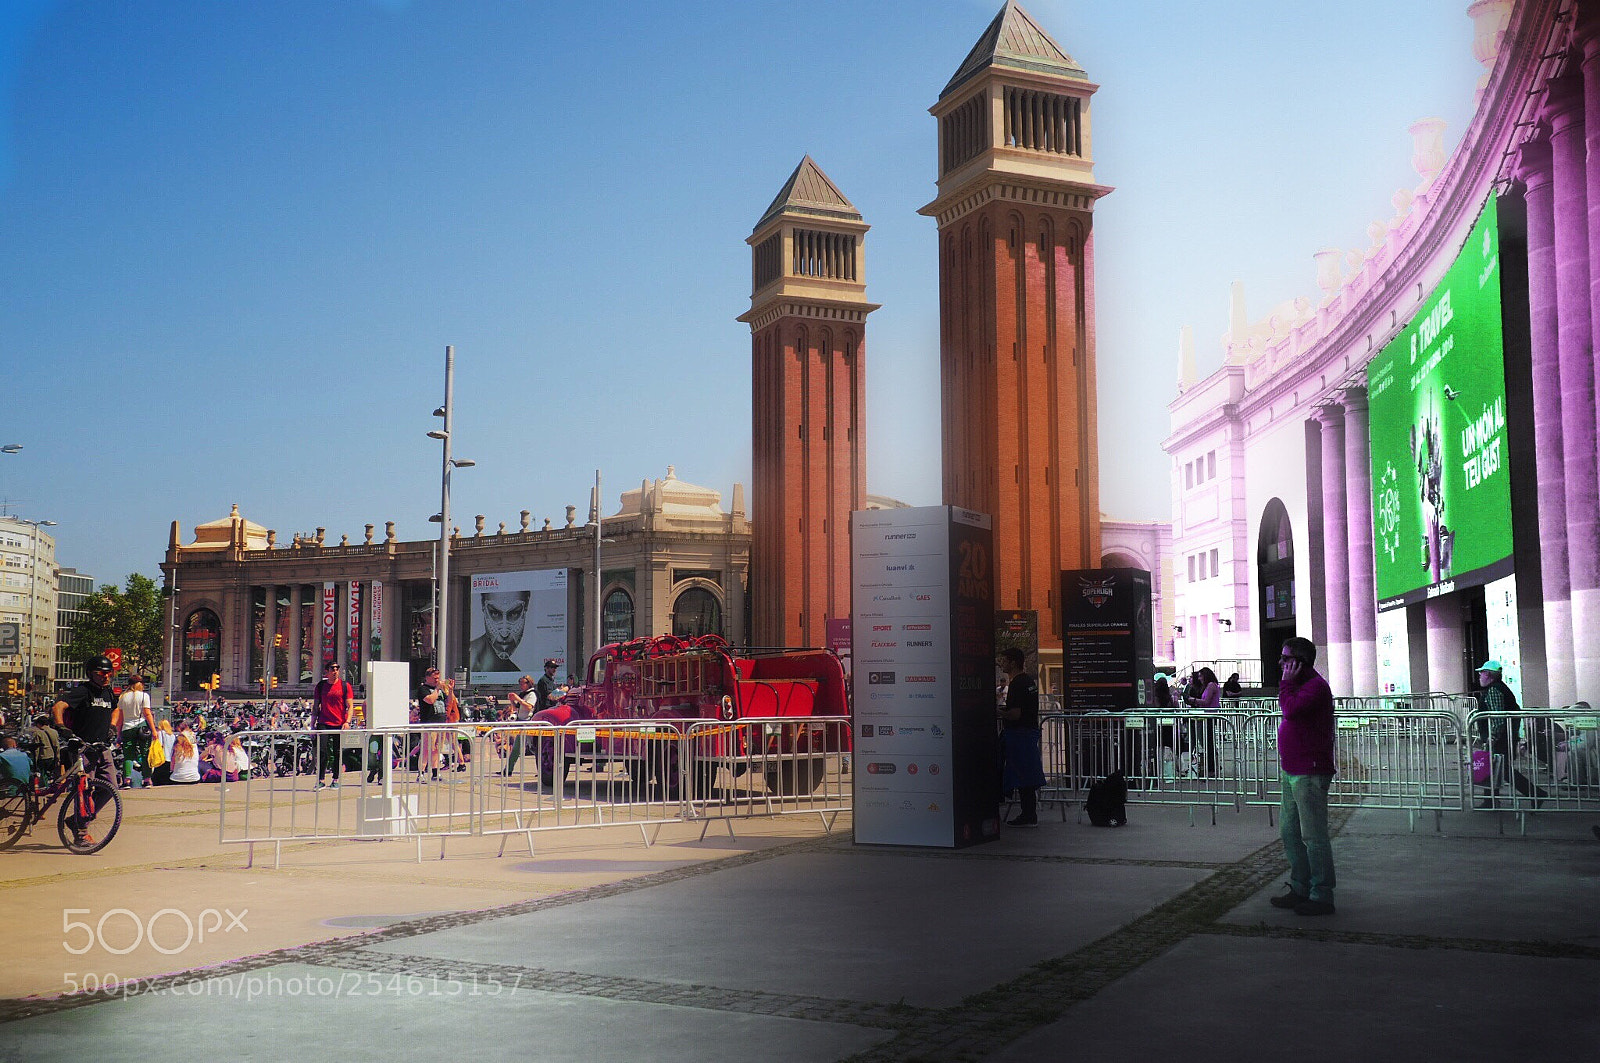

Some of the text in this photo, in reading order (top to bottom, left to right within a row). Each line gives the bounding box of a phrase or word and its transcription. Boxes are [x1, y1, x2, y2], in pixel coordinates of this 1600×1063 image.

[1419, 289, 1454, 354] TRAVEL
[1462, 423, 1475, 458] UN
[1495, 395, 1505, 433] AL
[1463, 436, 1501, 491] TEU GUST
[473, 579, 499, 588] BRIDAL
